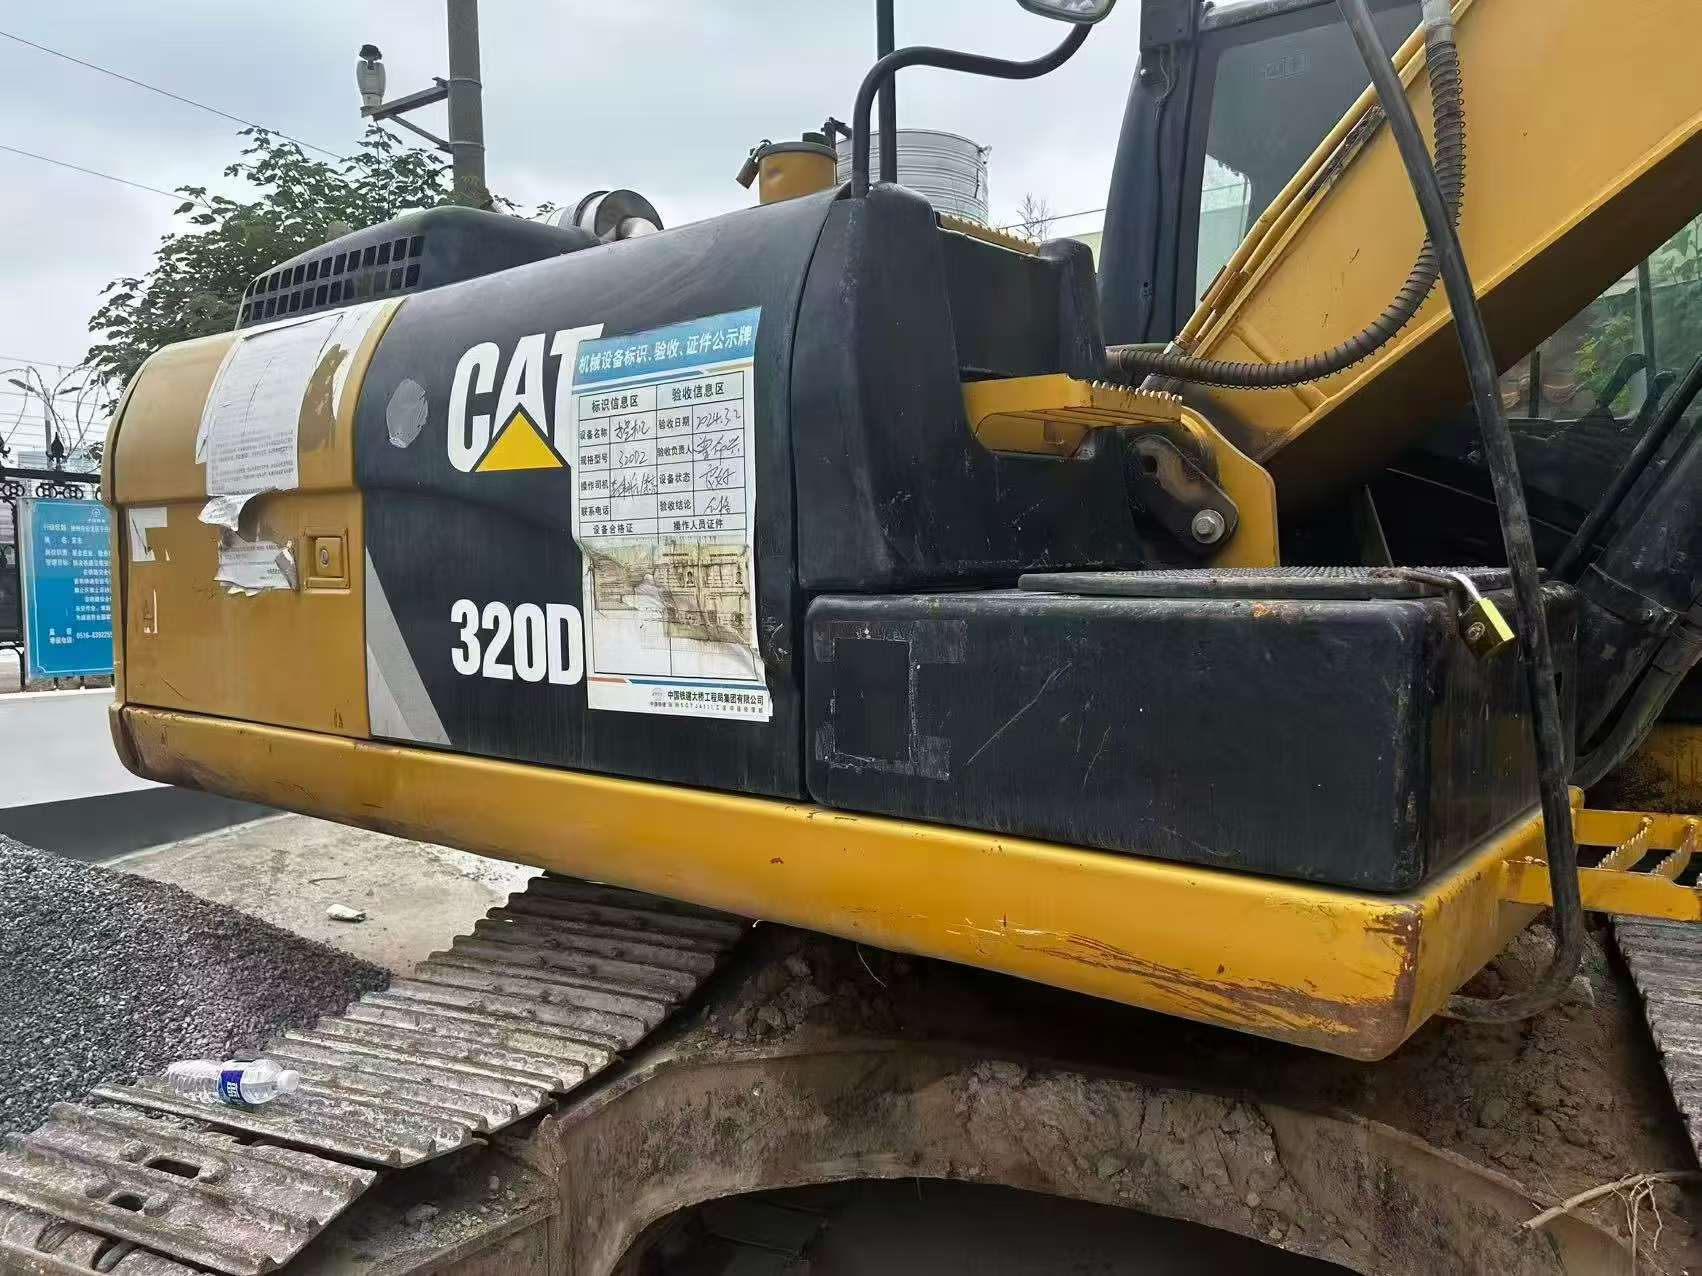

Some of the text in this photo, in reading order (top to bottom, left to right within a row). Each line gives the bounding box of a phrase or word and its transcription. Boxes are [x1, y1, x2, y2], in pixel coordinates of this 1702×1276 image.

[447, 323, 604, 472] CAT
[672, 382, 724, 401] 验收信息区
[592, 395, 639, 413] 标识信息区
[658, 415, 690, 430] 验收日期
[580, 427, 608, 440] 设备名称
[657, 444, 694, 457] 验收负责人
[580, 453, 608, 466] 规格型号
[659, 472, 691, 484] 设备状态
[581, 479, 609, 491] 操作司机
[581, 505, 609, 517] 联系电话
[659, 500, 692, 512] 验收结论
[593, 523, 634, 535] 设备合格证
[673, 519, 724, 531] 操作人员证件
[450, 599, 584, 685] 320D
[667, 690, 764, 705] 中国铁建大桥工程局集团有限公司
